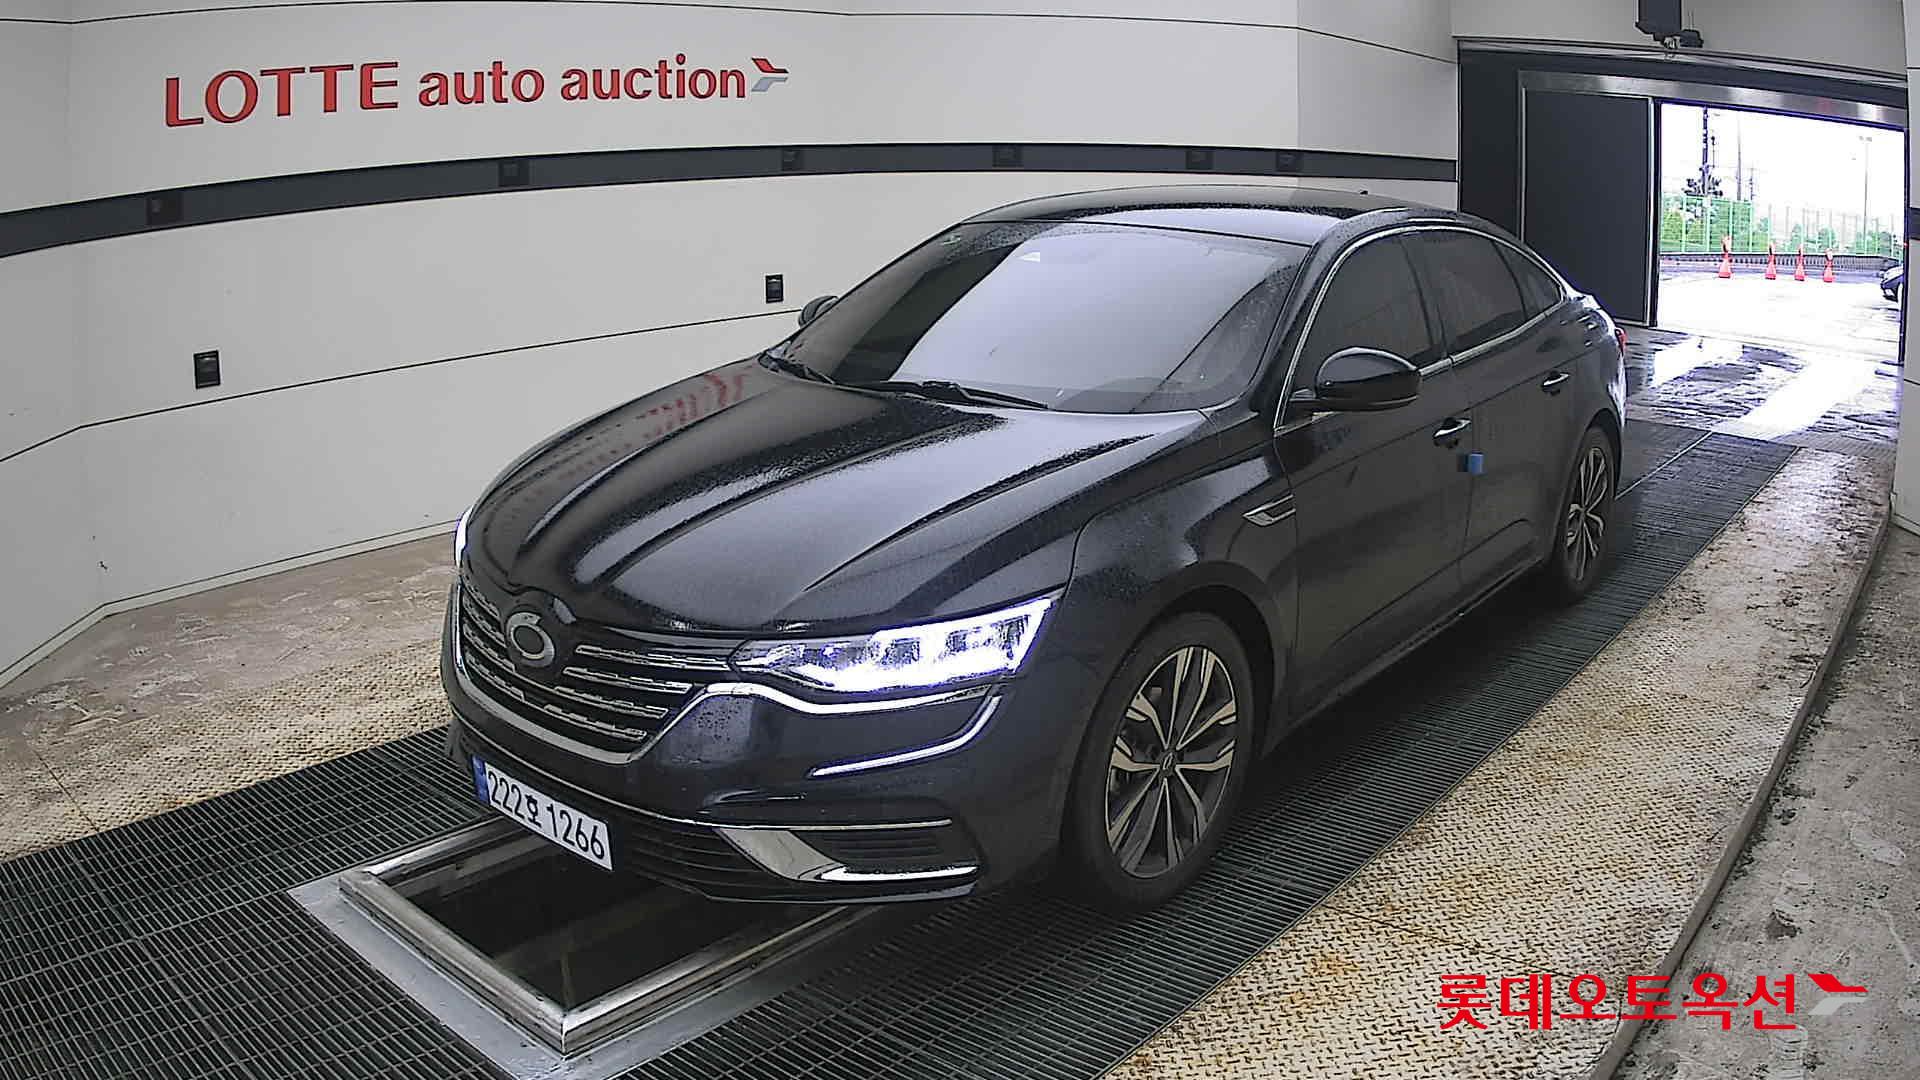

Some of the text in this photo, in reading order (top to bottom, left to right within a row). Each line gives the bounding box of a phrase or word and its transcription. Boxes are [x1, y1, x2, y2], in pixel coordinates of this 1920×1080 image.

[165, 53, 747, 127] LOTTE auto auction
[488, 771, 605, 860] 222호 1266
